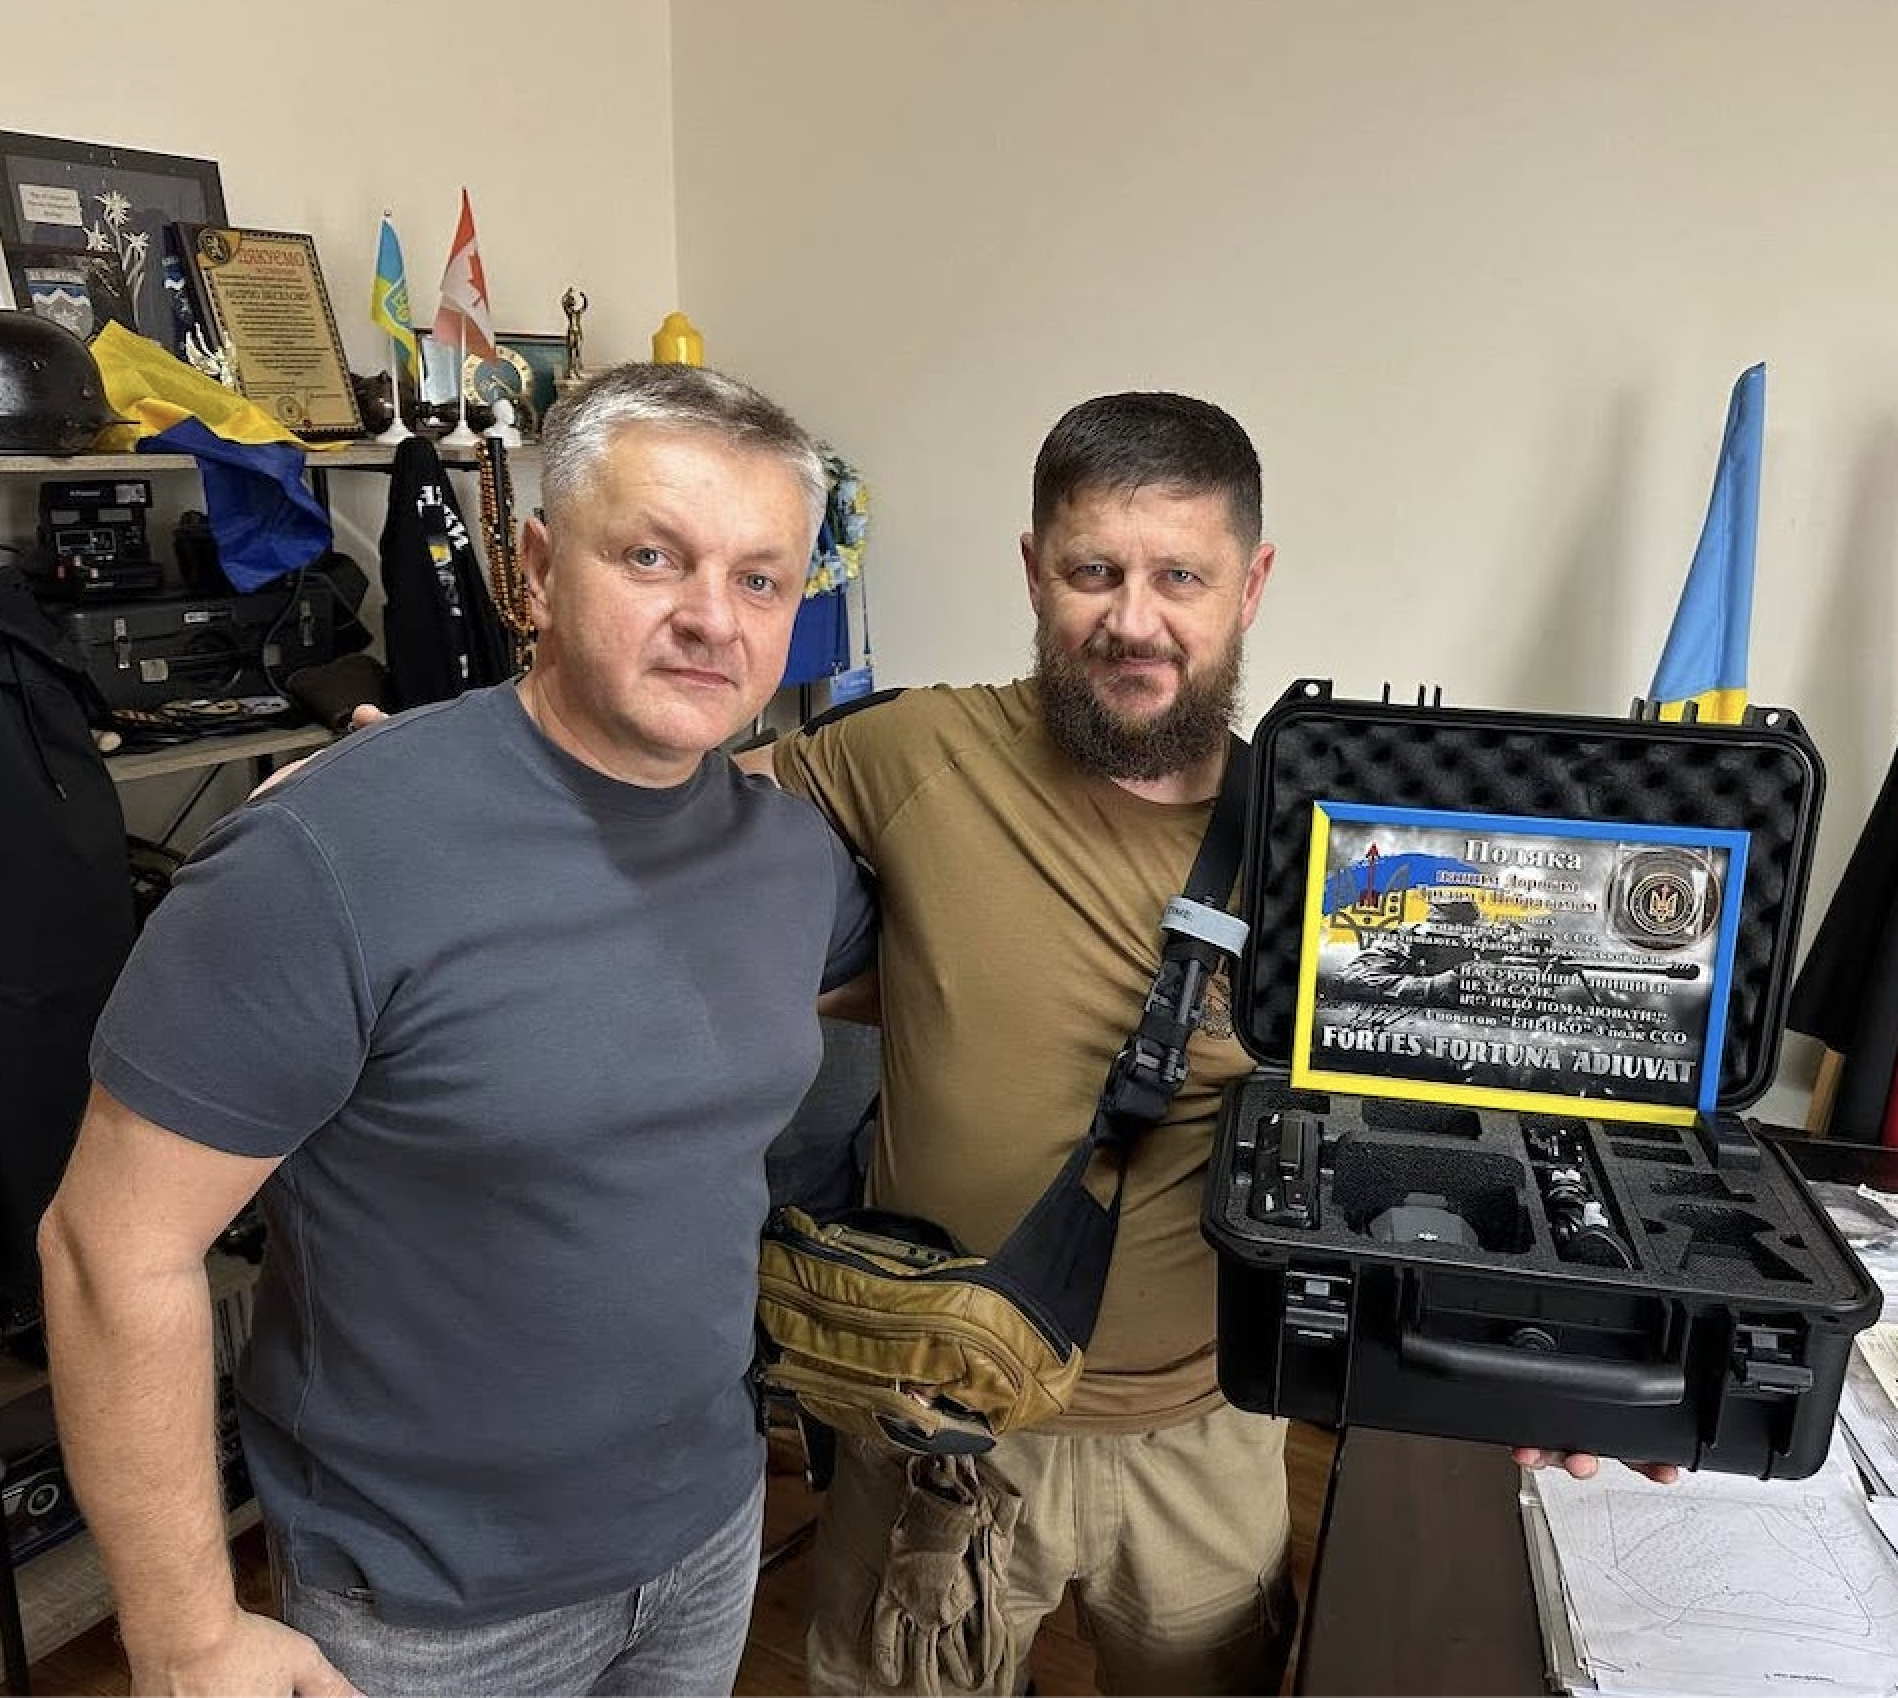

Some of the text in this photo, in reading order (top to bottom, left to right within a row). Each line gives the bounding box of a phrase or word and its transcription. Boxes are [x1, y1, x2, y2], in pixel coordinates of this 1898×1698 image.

[1464, 839, 1582, 871] Подяка
[1649, 1030, 1687, 1045] ССО
[1322, 1025, 1697, 1083] FORTES FORTUNA ADIUVAT
